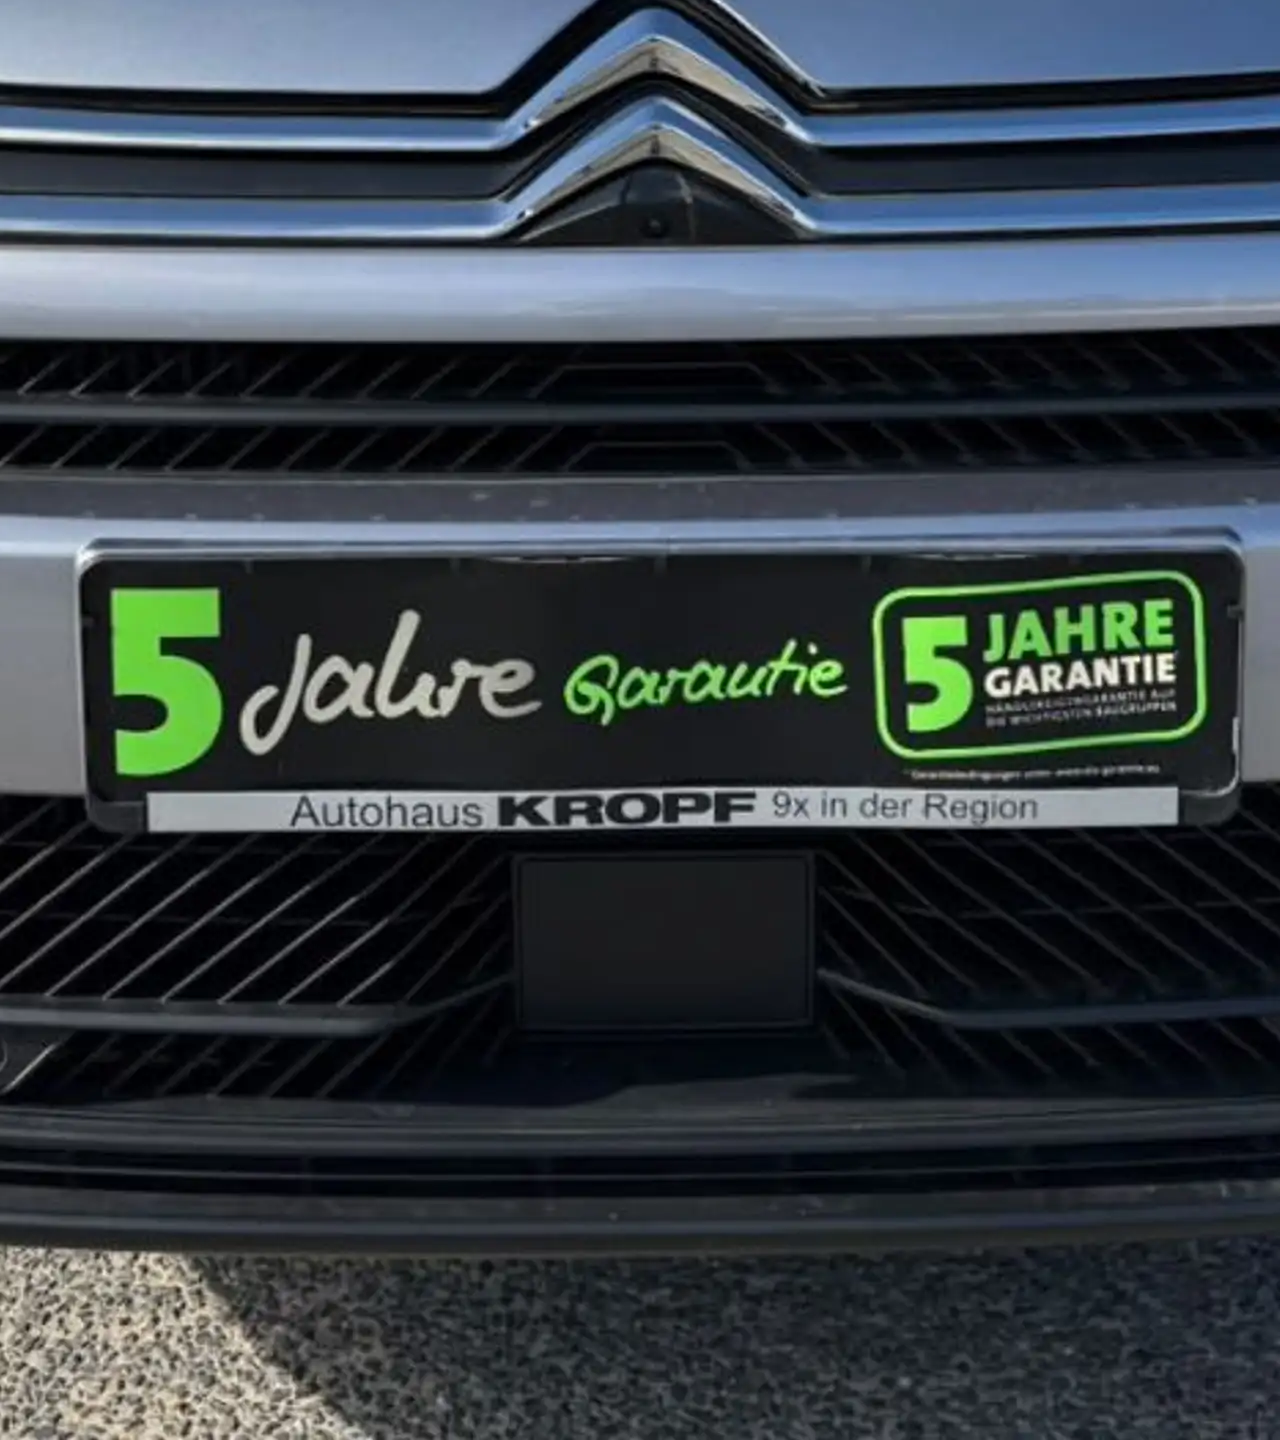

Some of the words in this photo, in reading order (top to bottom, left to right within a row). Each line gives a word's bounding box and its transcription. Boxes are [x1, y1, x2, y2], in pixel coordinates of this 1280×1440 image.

[982, 598, 1175, 663] JAHRE
[110, 587, 223, 777] 5
[902, 616, 973, 732] 5
[984, 652, 1177, 698] GARANTIE
[290, 795, 484, 828] Autohaus
[497, 792, 757, 827] KROPF
[772, 790, 809, 819] 9x
[821, 791, 847, 819] in
[859, 791, 913, 820] der
[923, 792, 1038, 827] Region
